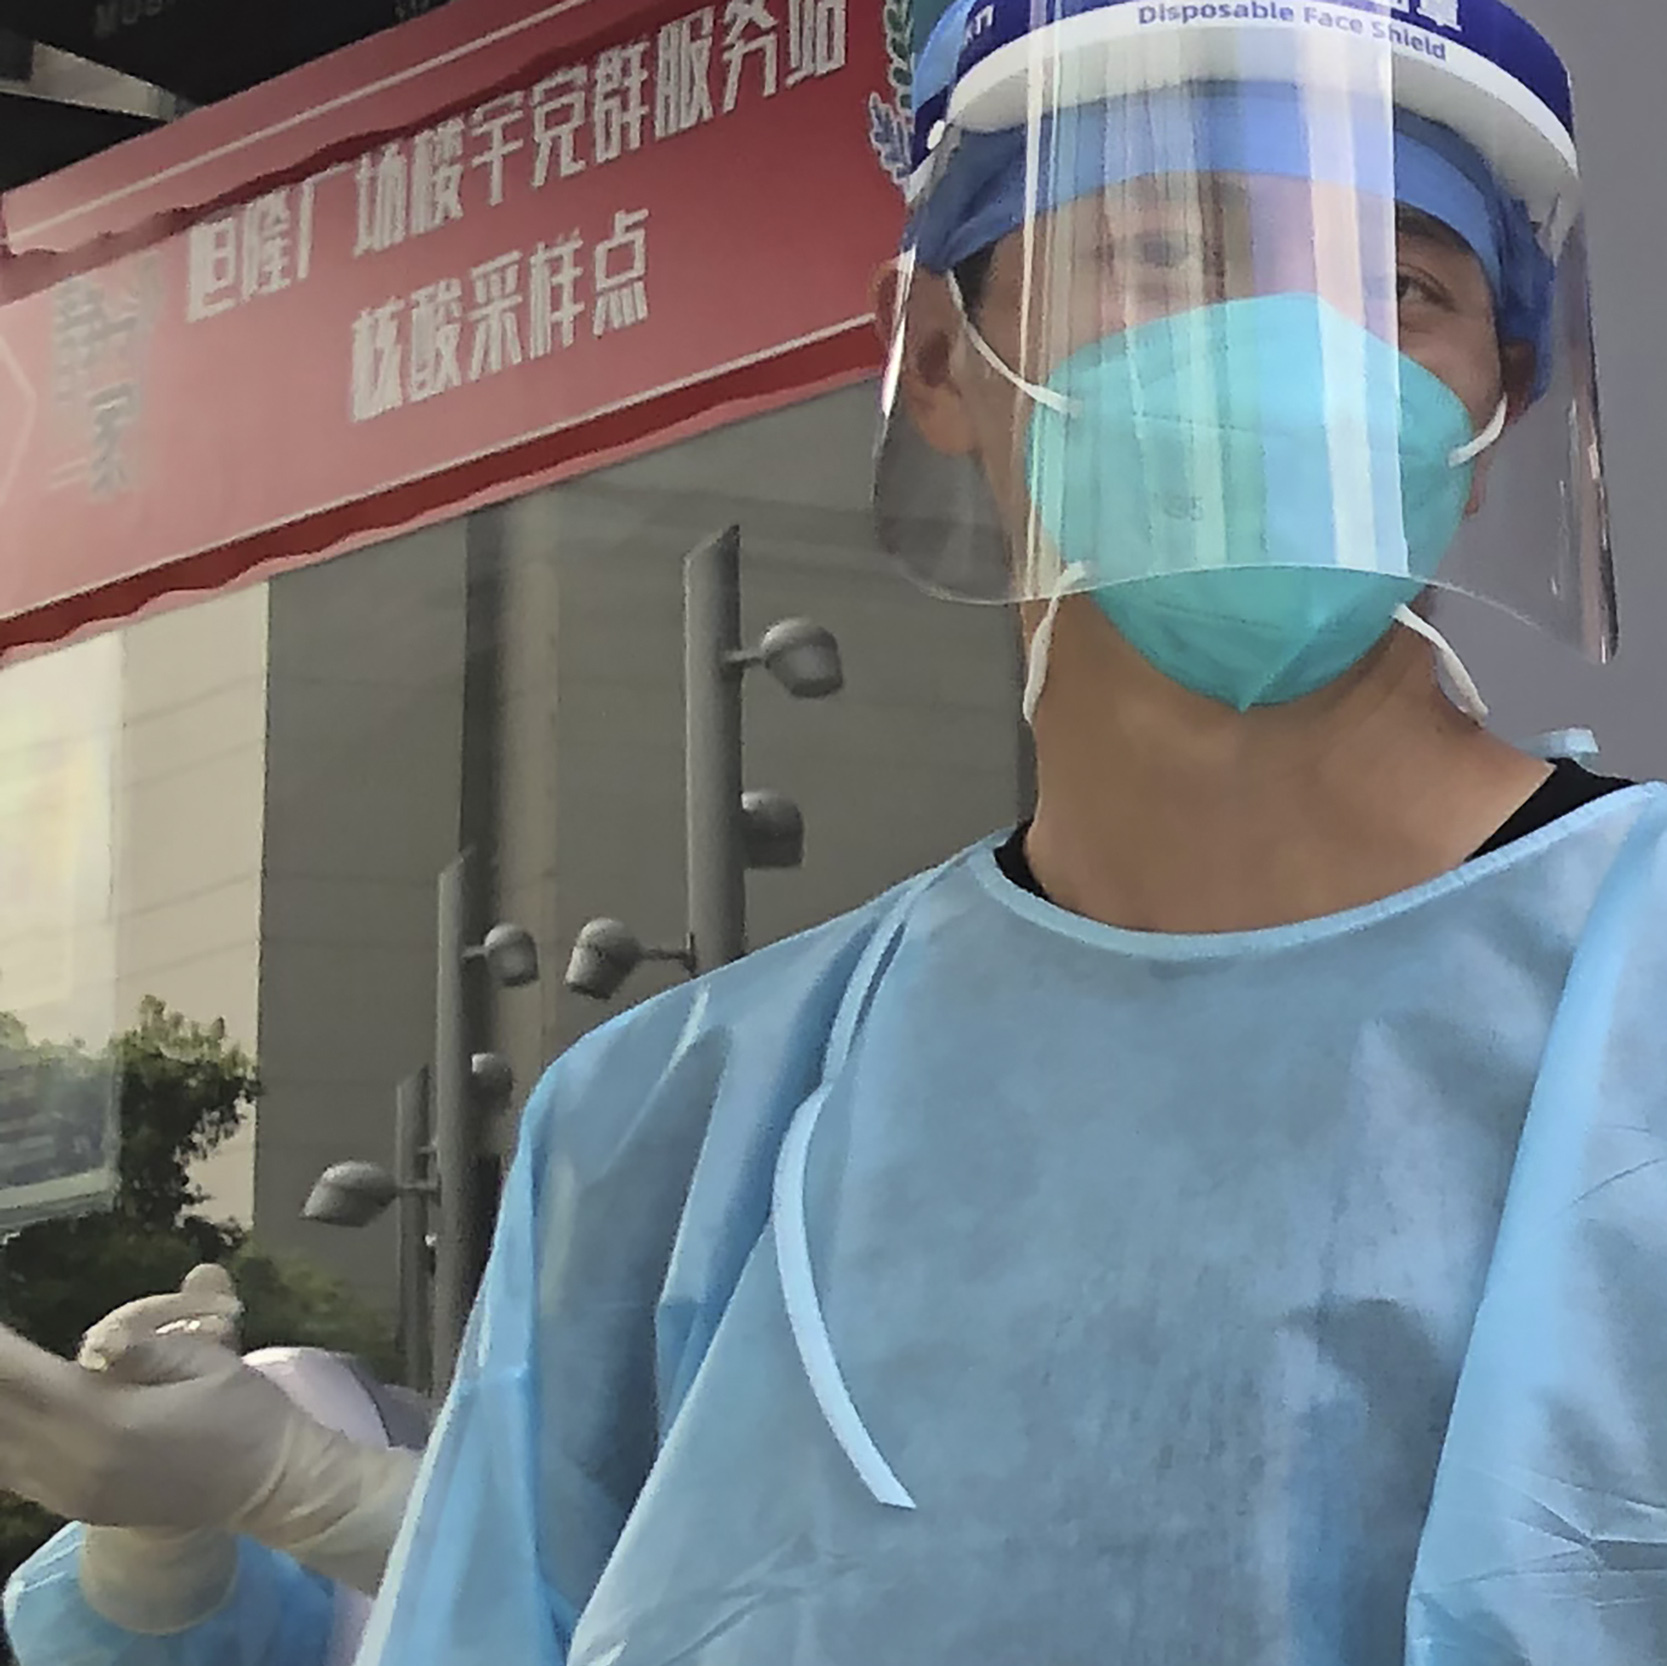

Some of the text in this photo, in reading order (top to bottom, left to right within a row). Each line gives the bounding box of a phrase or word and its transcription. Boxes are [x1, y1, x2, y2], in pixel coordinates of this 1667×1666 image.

[1138, 1, 1294, 25] Disposable
[1303, 7, 1363, 34] Face
[1371, 20, 1446, 61] Shield
[349, 208, 649, 423] 核酸采样点
